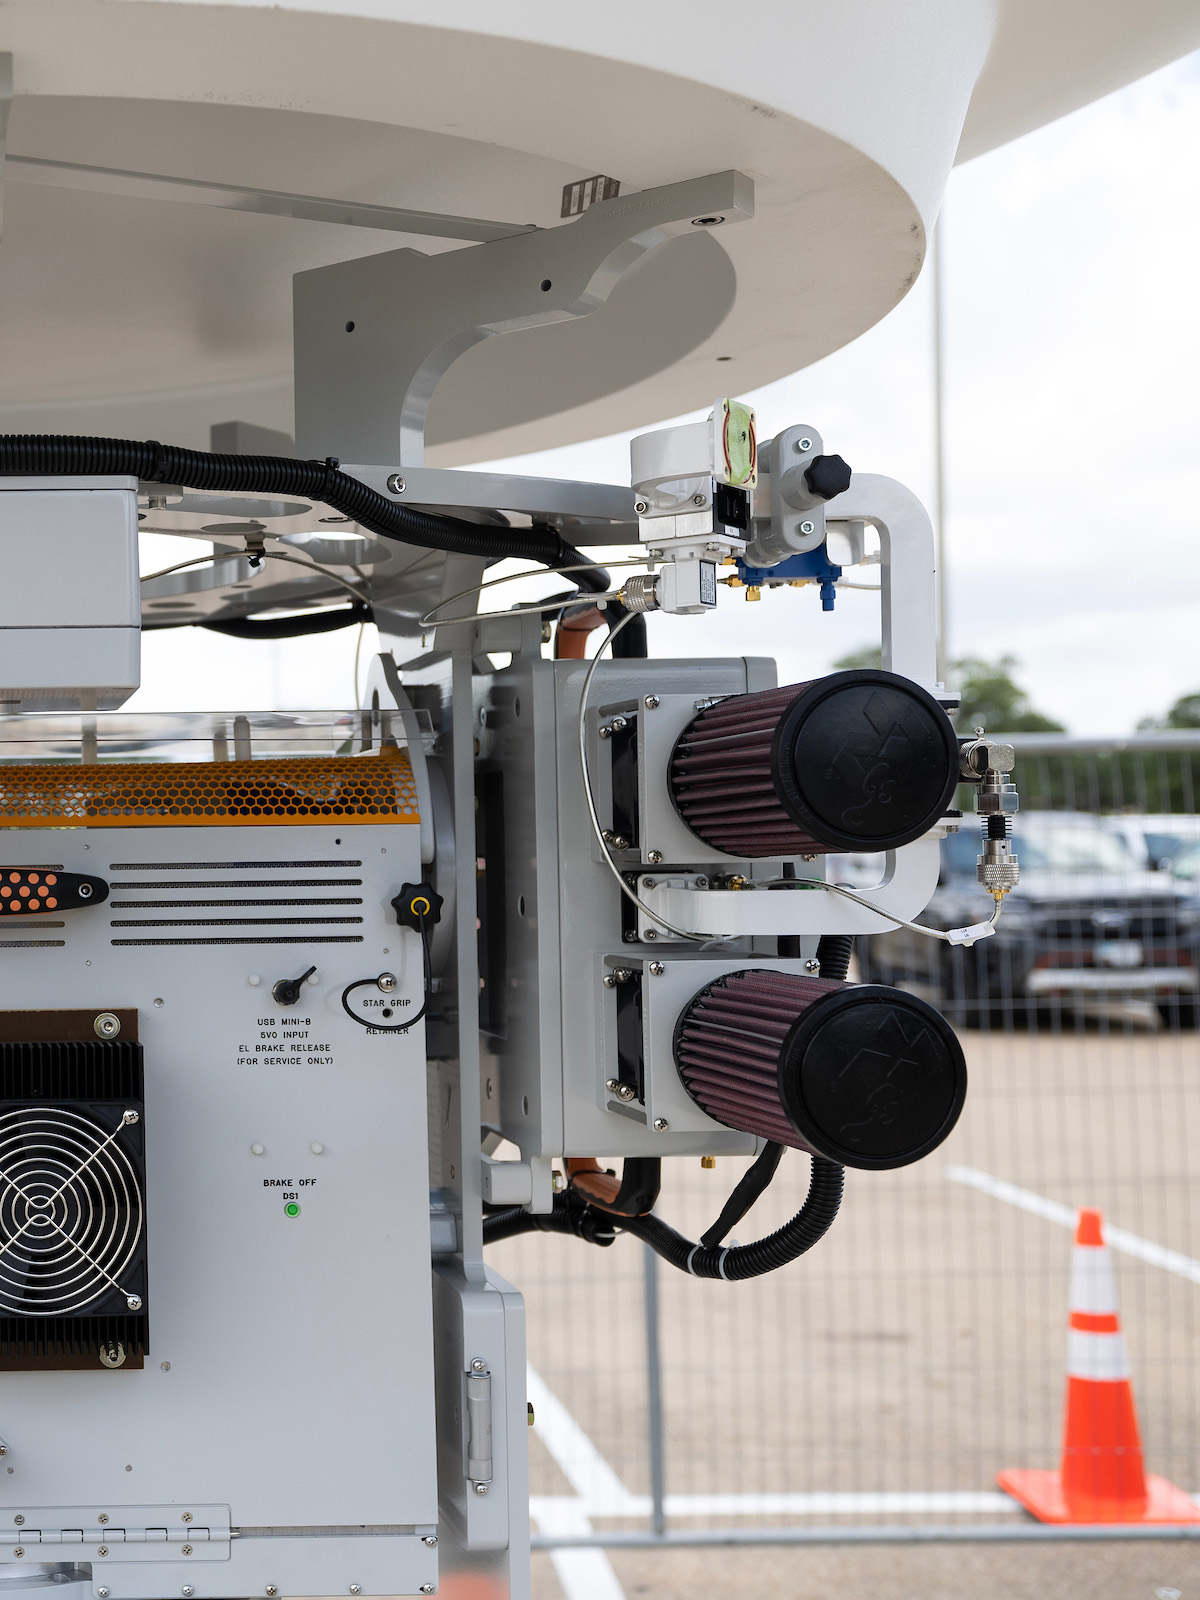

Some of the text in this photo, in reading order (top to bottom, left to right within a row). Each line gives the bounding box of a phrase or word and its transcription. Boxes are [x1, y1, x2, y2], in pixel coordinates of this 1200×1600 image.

[363, 999, 411, 1007] STAR GRIP
[257, 1018, 312, 1026] USB MINI-B
[283, 1031, 309, 1039] INPUT
[238, 1043, 331, 1053] EL BRAKE RELEASE
[237, 1057, 334, 1066] (FOR SERVICE ONLY)
[263, 1178, 317, 1187] BRAKE OFF
[282, 1192, 299, 1200] DS1
